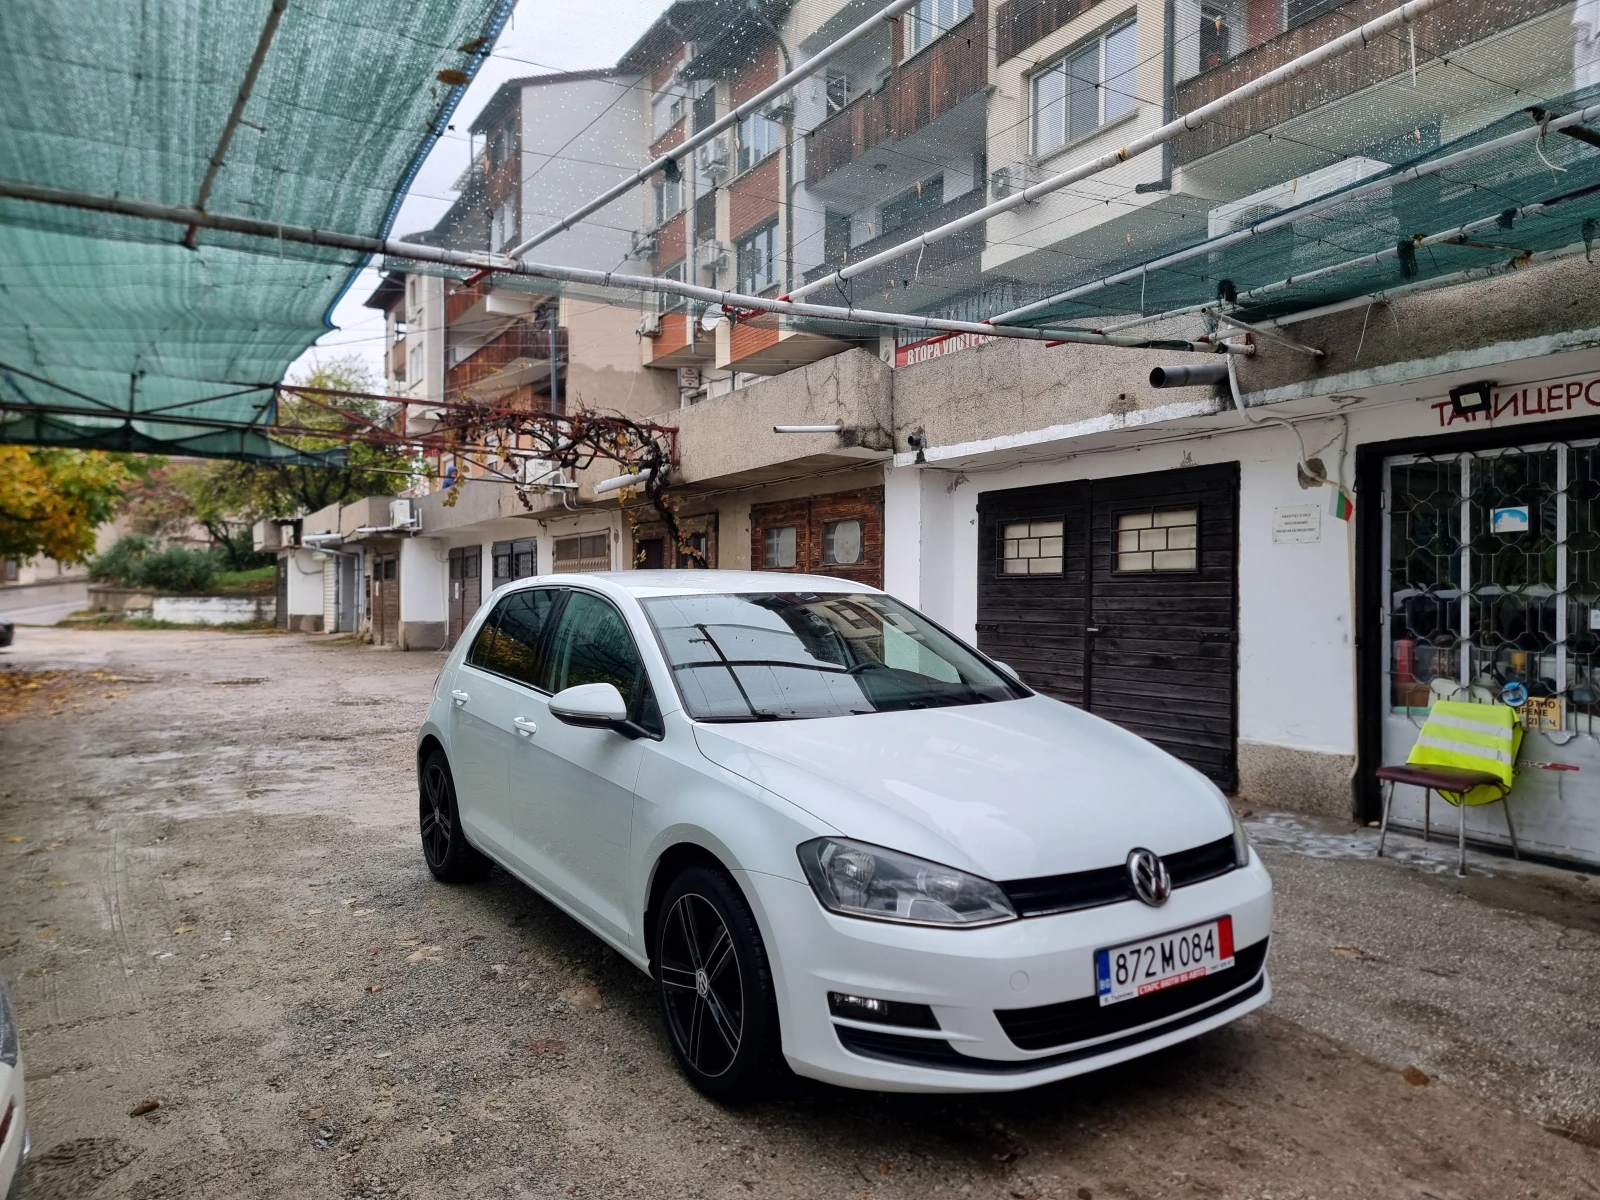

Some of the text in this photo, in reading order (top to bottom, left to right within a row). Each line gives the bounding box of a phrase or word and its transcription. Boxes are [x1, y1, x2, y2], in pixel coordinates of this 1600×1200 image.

[907, 343, 940, 365] ВТОРА
[1099, 978, 1111, 991] BG
[1139, 981, 1160, 995] СТАРС
